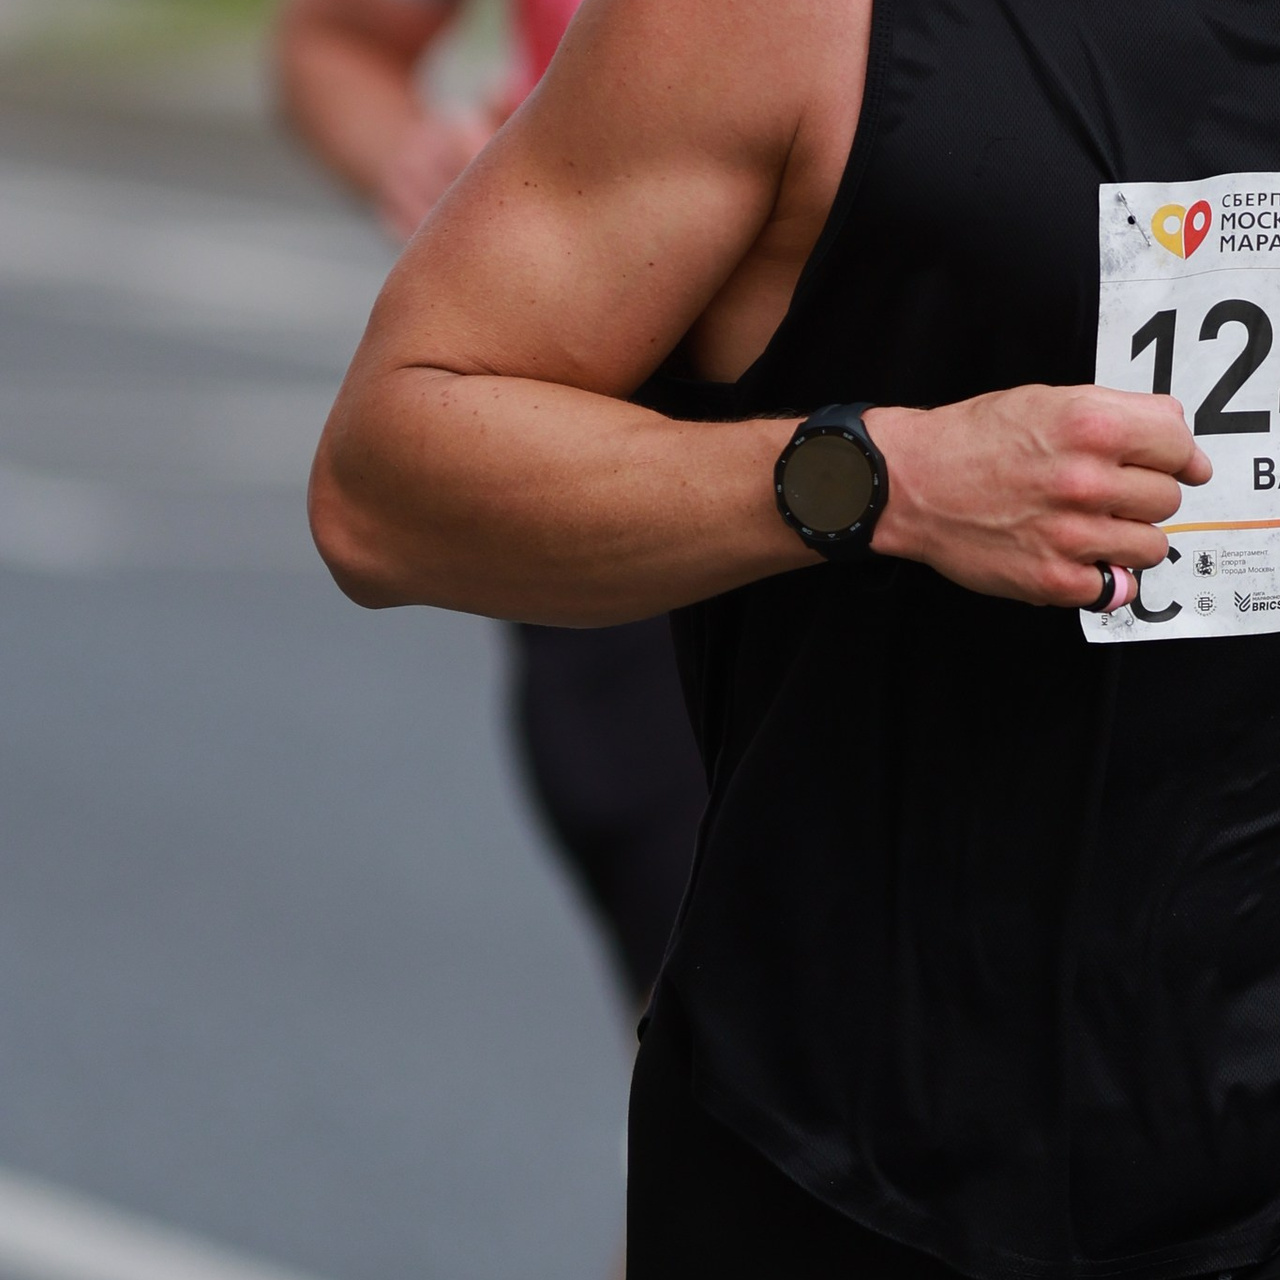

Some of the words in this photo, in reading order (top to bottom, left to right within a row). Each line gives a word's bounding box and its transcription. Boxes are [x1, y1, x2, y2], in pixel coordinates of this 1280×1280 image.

[1221, 549, 1268, 558] Департамент
[1221, 559, 1246, 568] спорта
[1248, 566, 1275, 574] Москвы
